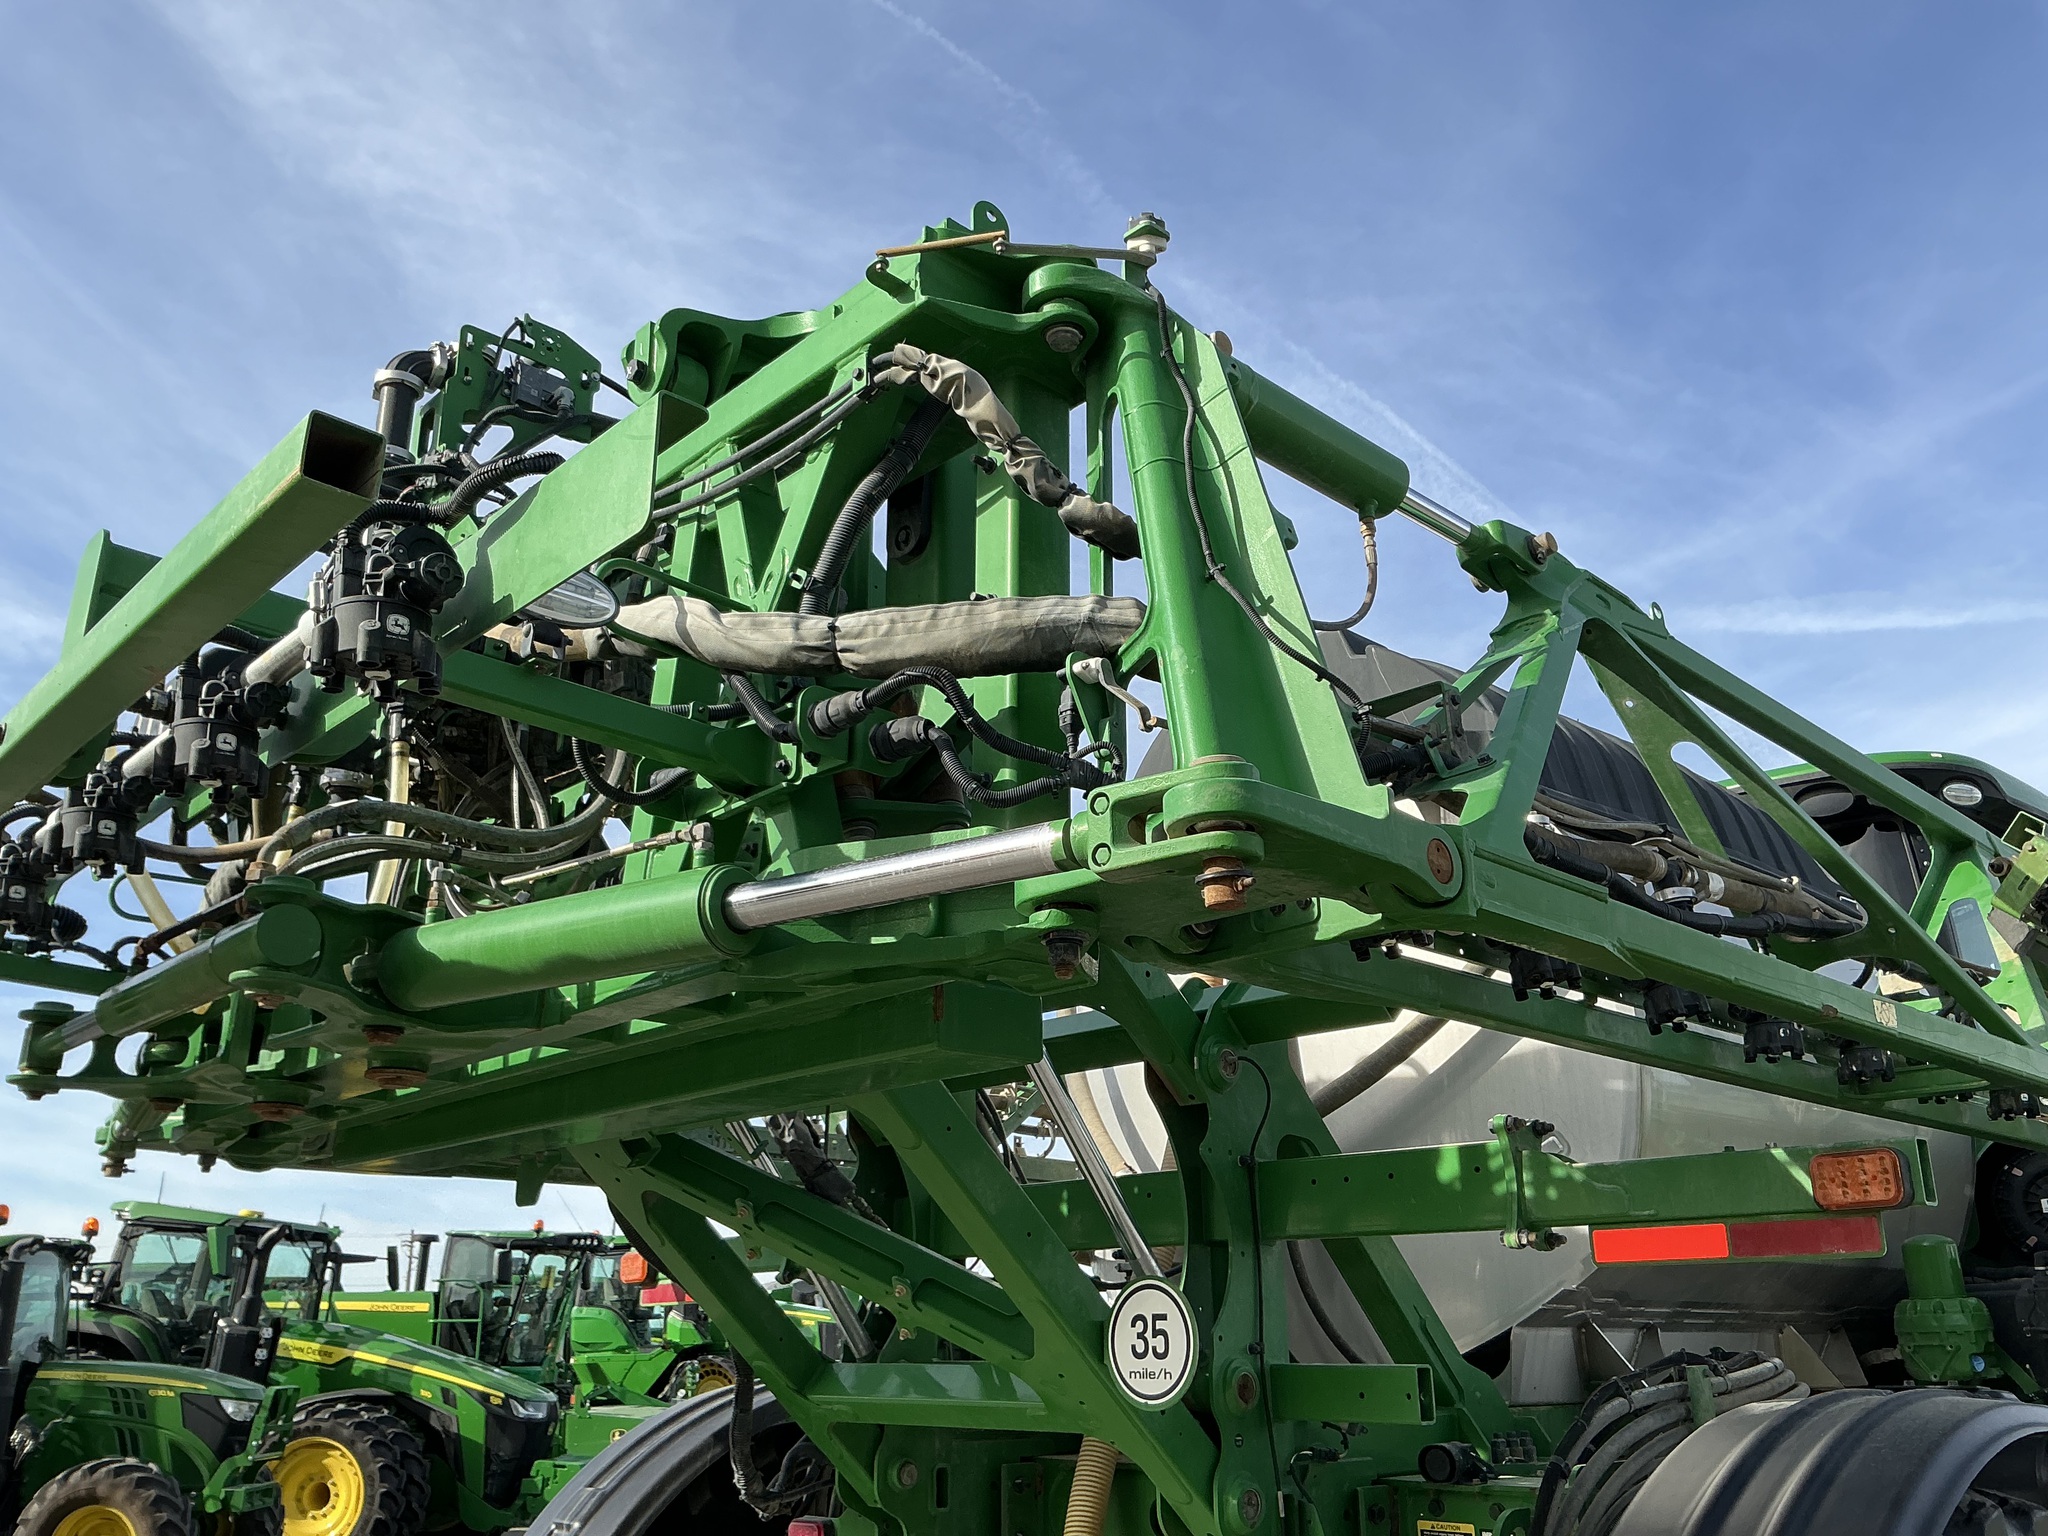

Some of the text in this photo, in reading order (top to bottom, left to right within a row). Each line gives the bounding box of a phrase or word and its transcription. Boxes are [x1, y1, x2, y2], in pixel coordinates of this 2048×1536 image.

[1130, 1313, 1170, 1360] 35
[282, 1342, 334, 1359] JOHN DEERE
[1129, 1368, 1172, 1380] mile/h
[1436, 1523, 1461, 1531] CAUTION
